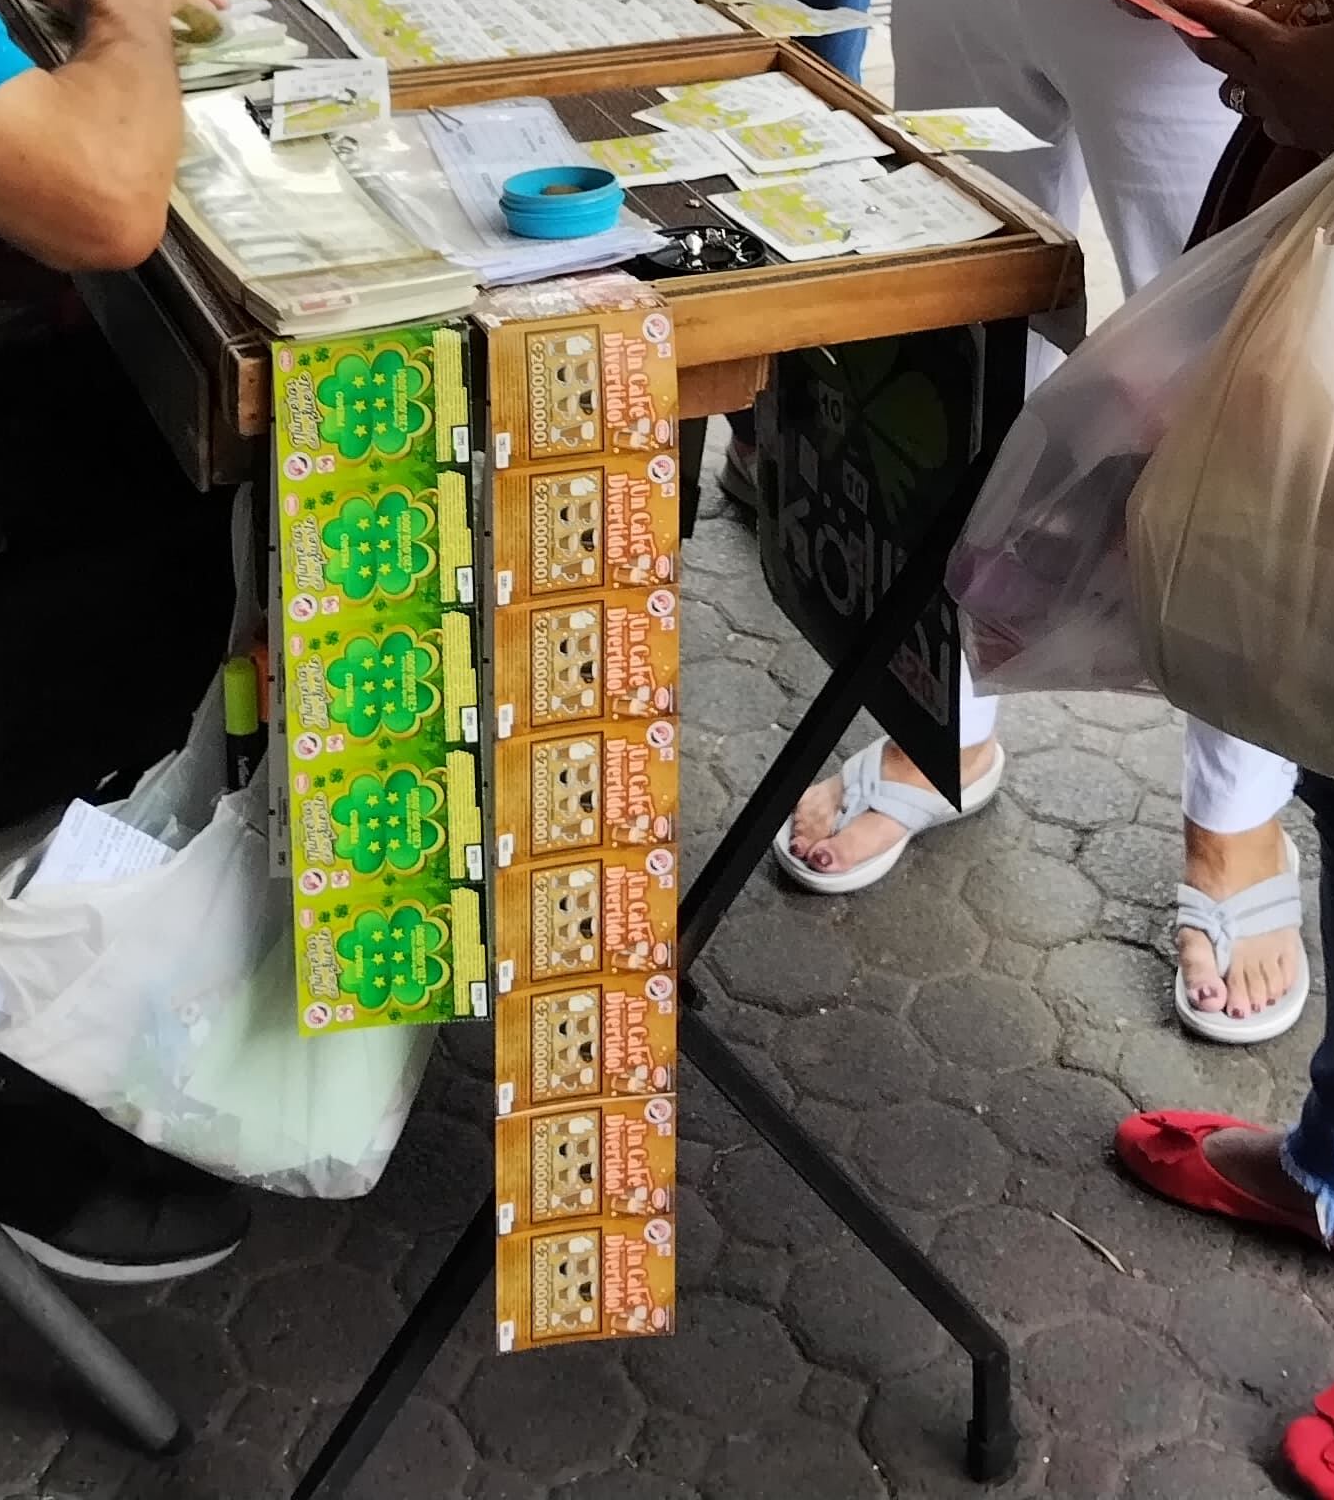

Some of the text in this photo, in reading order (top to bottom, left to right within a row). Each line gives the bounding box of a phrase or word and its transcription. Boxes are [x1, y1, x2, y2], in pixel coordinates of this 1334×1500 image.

[603, 332, 627, 428] Divertido!
[626, 339, 656, 419] ¡Un Café
[606, 474, 628, 564] Divertido!
[628, 479, 656, 555] ¡Un Café
[606, 608, 627, 696] Divertido!
[628, 613, 656, 687] ¡Un Café
[606, 739, 626, 825] Divertido!
[628, 744, 655, 815] ¡Un Café
[605, 866, 625, 950] Divertido!
[627, 871, 655, 942] ¡Un Café
[605, 992, 625, 1074] Divertido!
[627, 996, 654, 1065] ¡Un Café
[605, 1115, 624, 1196] Divertido!
[626, 1119, 653, 1187] ¡Un Café
[605, 1235, 624, 1313] Divertido!
[626, 1240, 653, 1306] ¡Un Café
